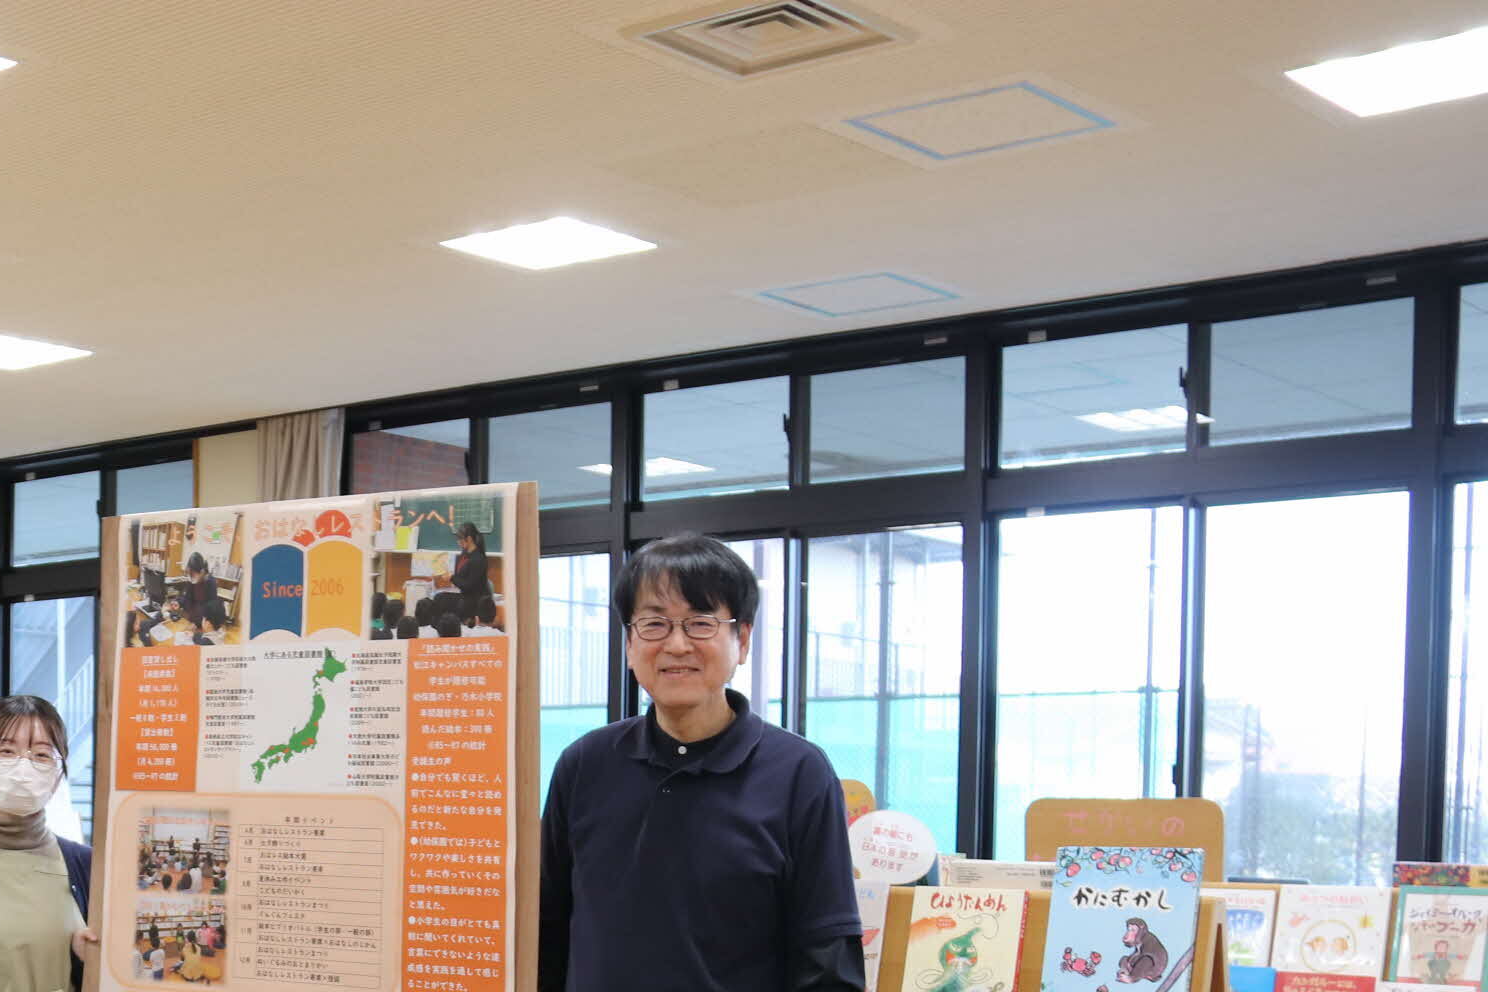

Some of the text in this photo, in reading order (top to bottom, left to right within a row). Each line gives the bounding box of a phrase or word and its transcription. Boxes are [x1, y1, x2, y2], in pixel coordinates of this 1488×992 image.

[262, 578, 344, 598] Since 2006
[930, 892, 1008, 912] ひょうたんめん
[1072, 887, 1174, 911] かにむかし
